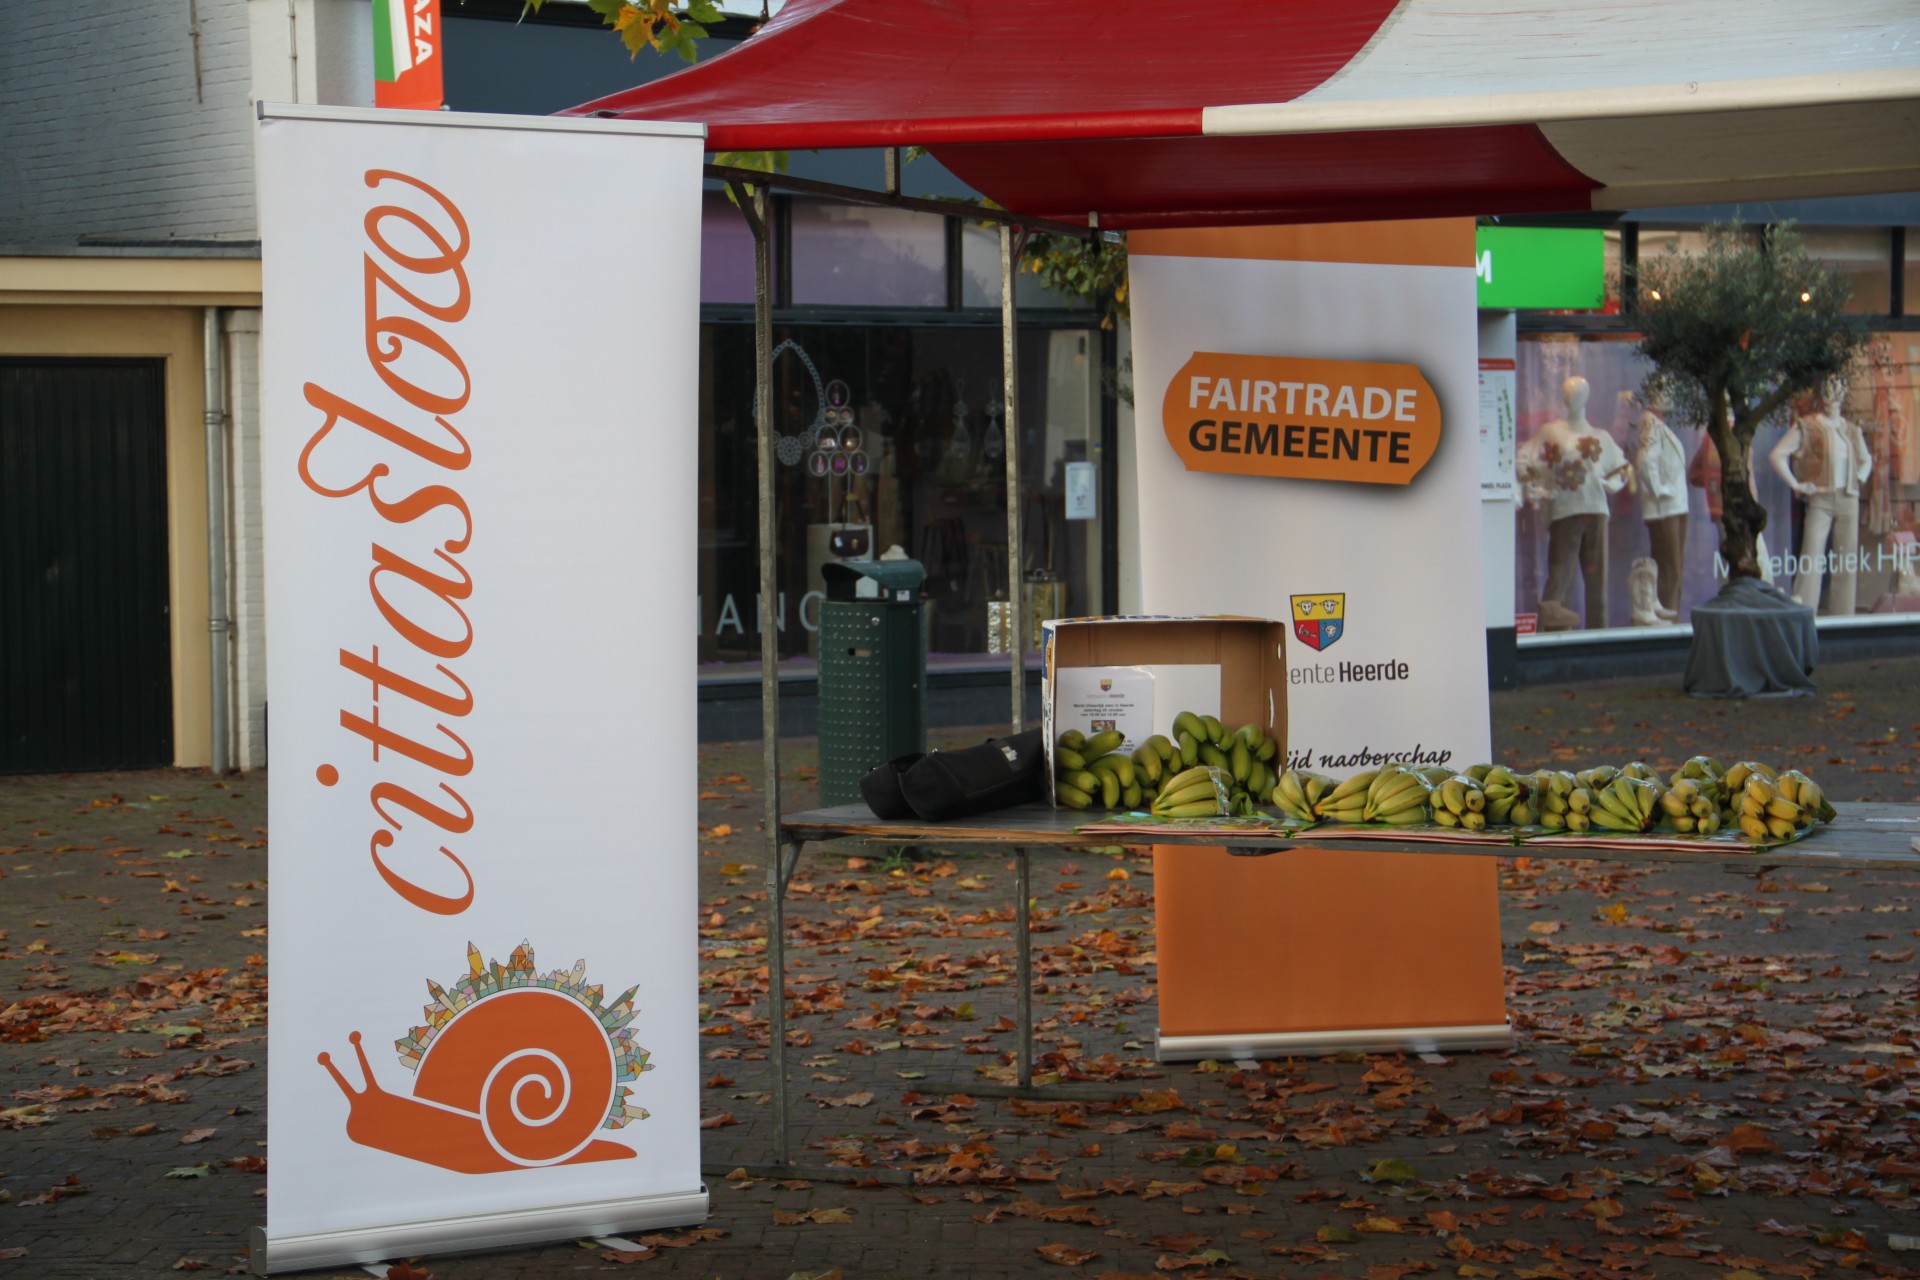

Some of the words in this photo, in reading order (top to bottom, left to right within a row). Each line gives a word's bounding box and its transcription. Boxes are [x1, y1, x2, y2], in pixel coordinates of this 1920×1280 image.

[1189, 375, 1417, 422] FAIRTRADE
[1188, 419, 1411, 464] GEMEENTE
[298, 168, 475, 916] cittaslow
[1713, 544, 1871, 579] Meboetiek
[1287, 663, 1335, 685] ente
[1339, 659, 1409, 683] Heerde
[1319, 743, 1452, 769] naoberschap
